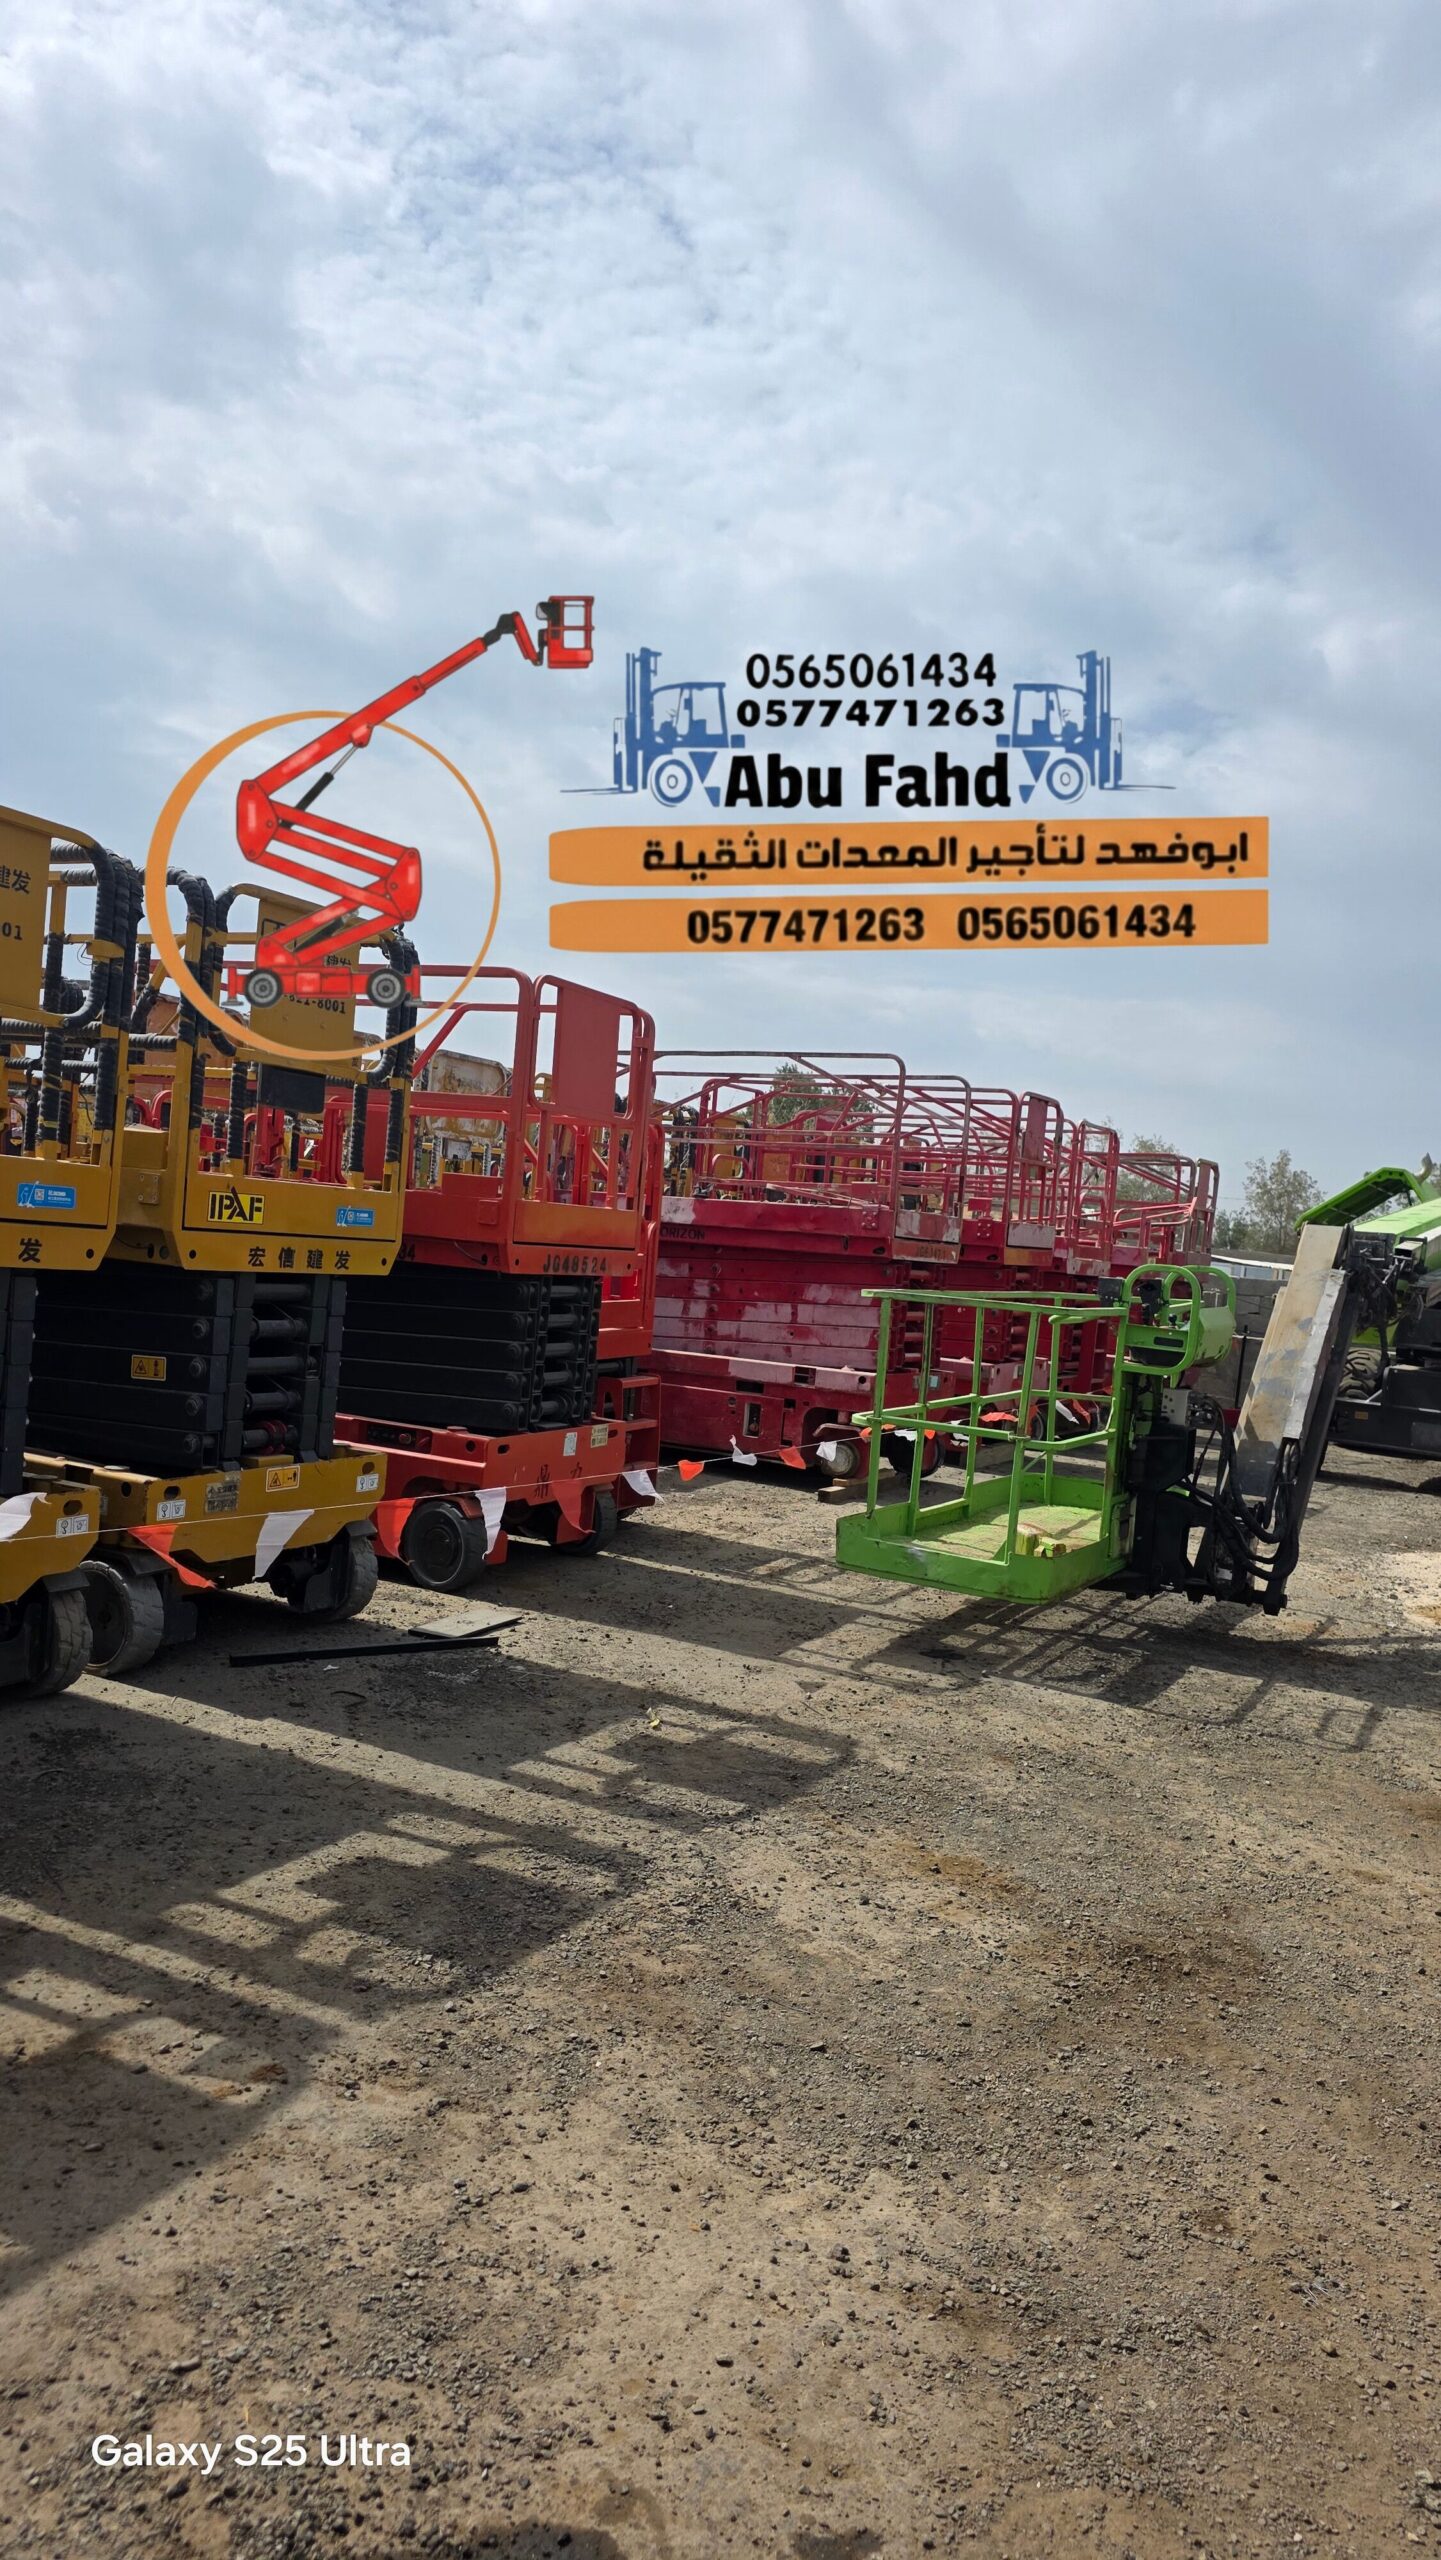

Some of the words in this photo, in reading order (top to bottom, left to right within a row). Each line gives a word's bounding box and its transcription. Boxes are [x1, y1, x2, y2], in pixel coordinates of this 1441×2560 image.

[210, 1187, 263, 1222] IPAF
[248, 1246, 351, 1270] 宏信建发
